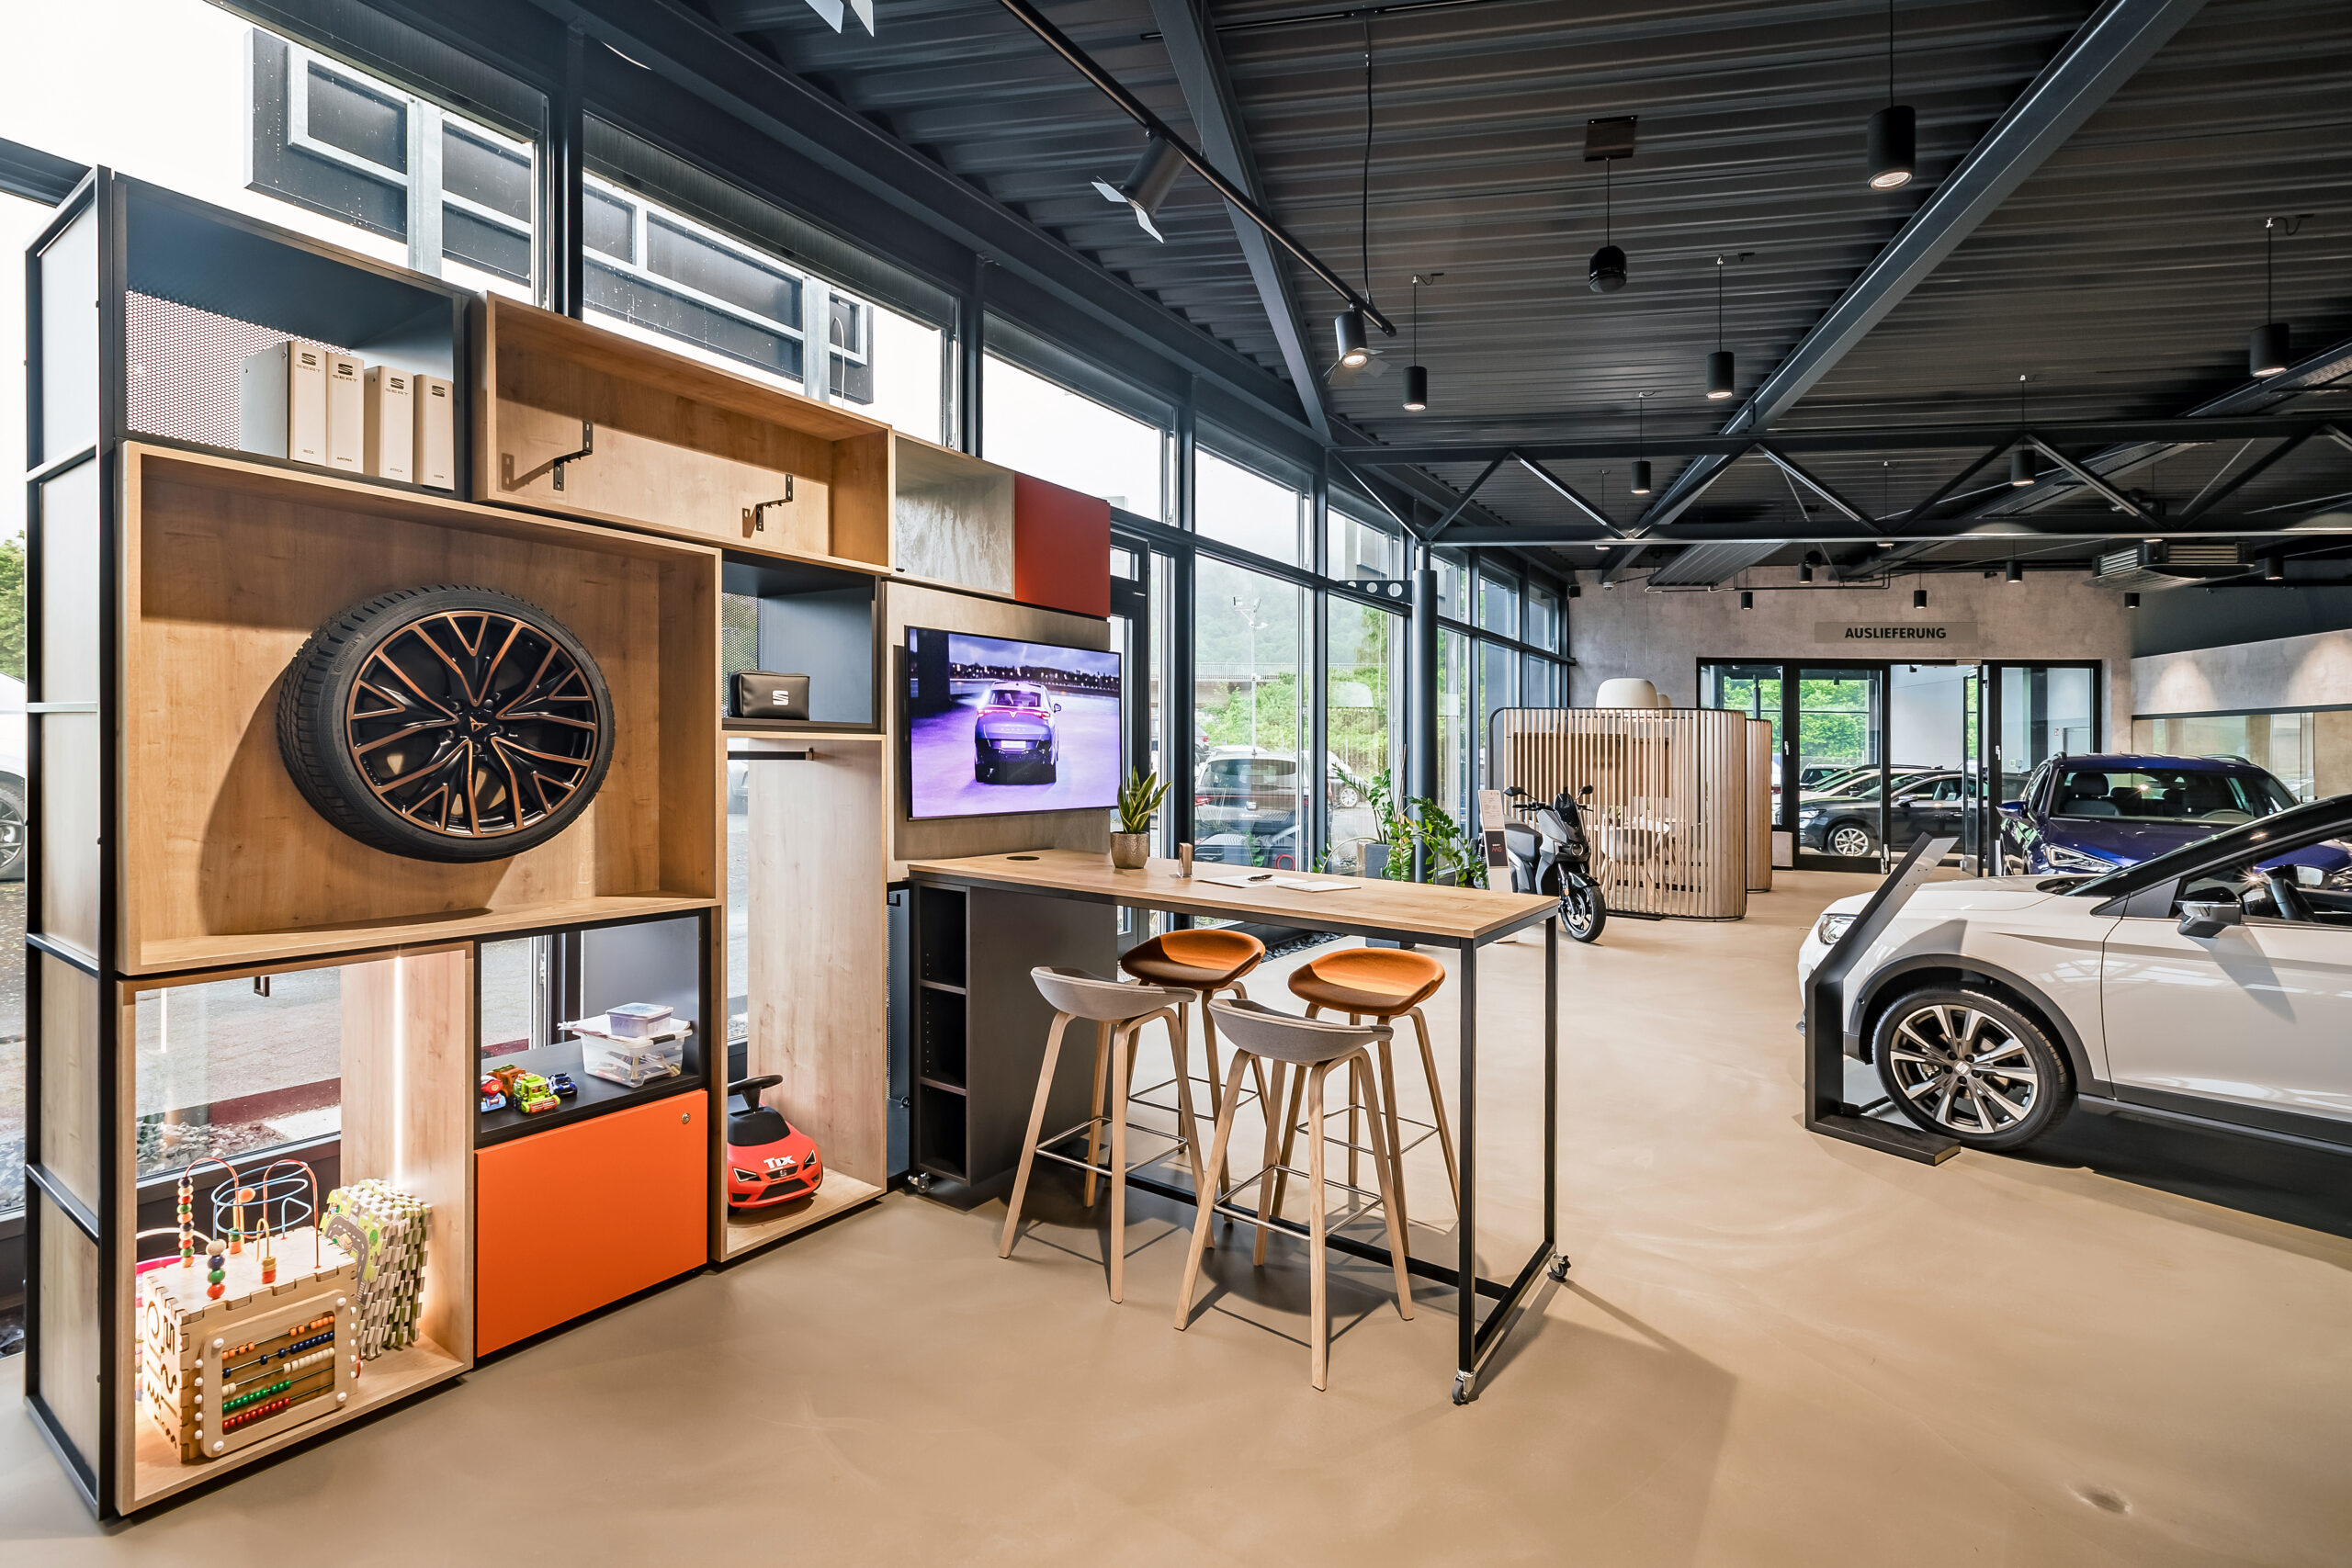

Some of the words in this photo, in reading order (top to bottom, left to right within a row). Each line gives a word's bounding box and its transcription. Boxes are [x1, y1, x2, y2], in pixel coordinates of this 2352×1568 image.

[296, 364, 321, 373] SEAT
[333, 374, 358, 383] SEAT
[385, 388, 409, 396] SEAT
[1845, 627, 1947, 639] AUSLIEFERUNG
